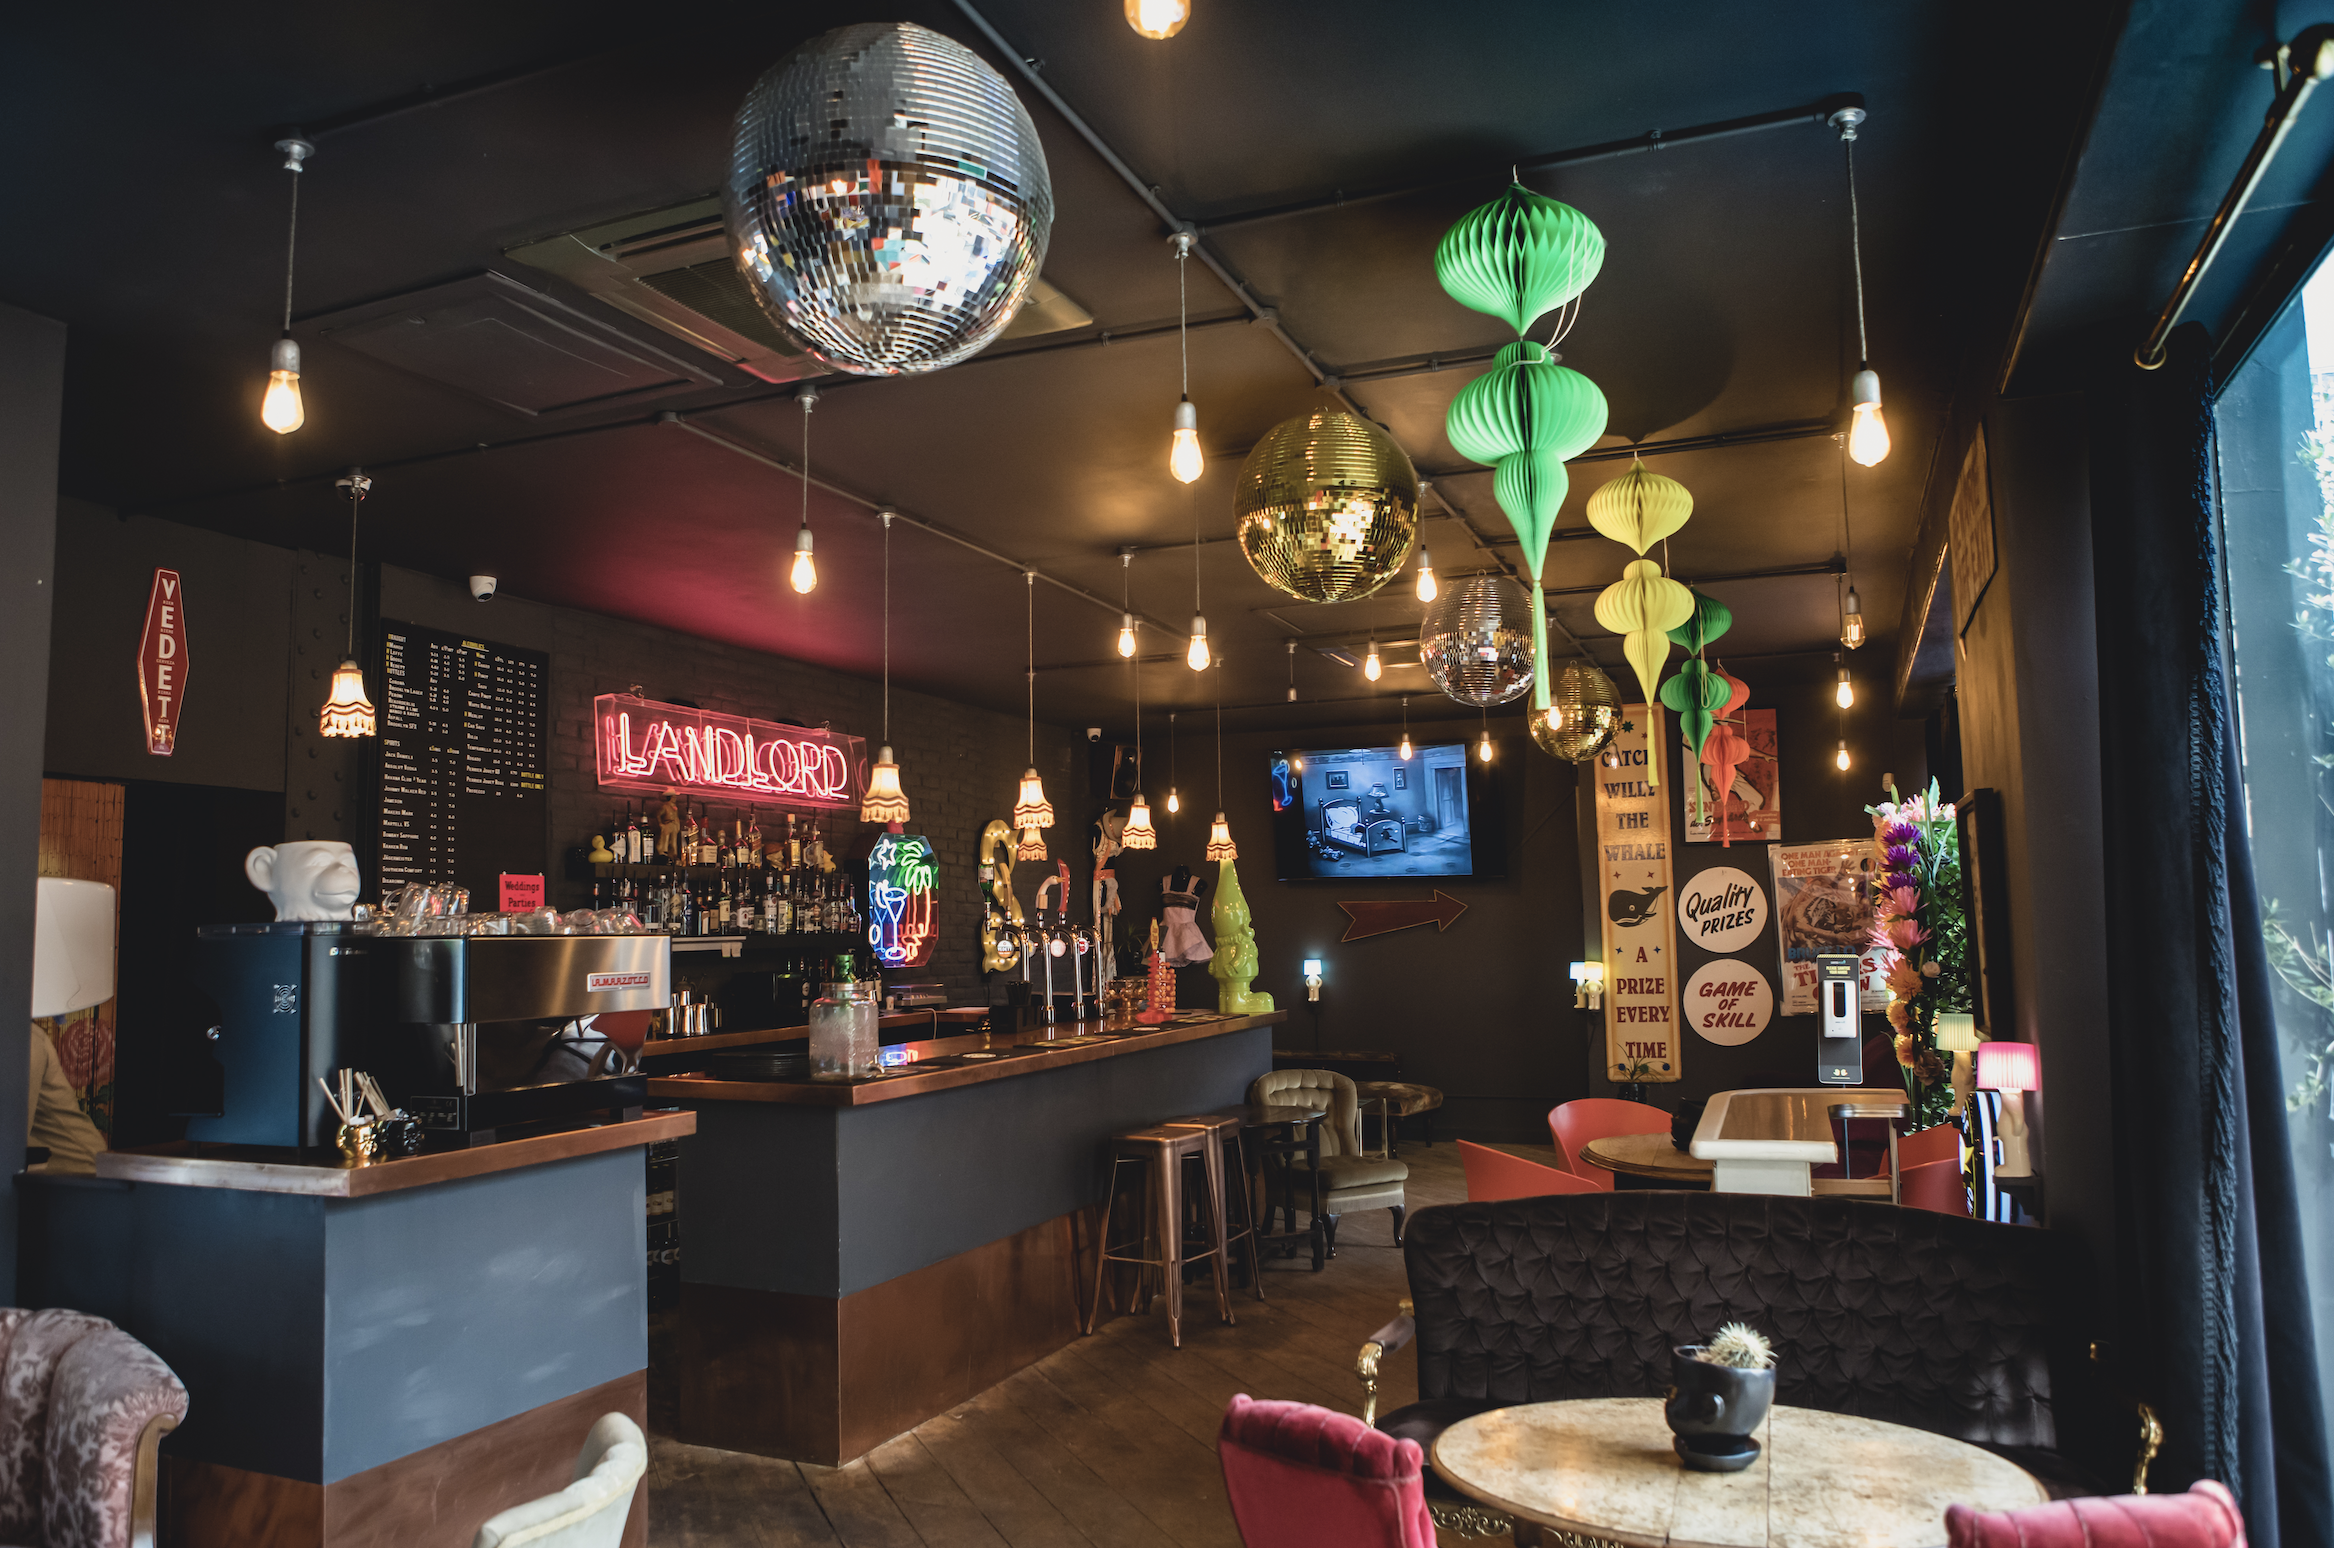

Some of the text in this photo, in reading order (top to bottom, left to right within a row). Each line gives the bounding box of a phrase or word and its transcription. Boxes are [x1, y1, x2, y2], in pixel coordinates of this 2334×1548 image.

[158, 578, 176, 744] VEDETT
[618, 712, 850, 799] LANDLORD
[1616, 812, 1649, 829] THE
[1604, 843, 1666, 861] WHALE
[1781, 852, 1799, 860] ONE
[1800, 850, 1821, 859] MAN
[1782, 866, 1836, 877] EATING TIGER
[1788, 860, 1806, 868] ONE
[505, 881, 540, 893] Weddings
[508, 897, 536, 907] Parties
[1686, 882, 1754, 923] Quality
[1701, 908, 1755, 936] PRIZES
[1636, 946, 1648, 963] A
[1616, 977, 1665, 995] PRIZE
[1699, 981, 1758, 997] GAME
[1718, 998, 1739, 1010] OF
[1616, 1006, 1670, 1023] EVERY
[1702, 1012, 1756, 1028] SKILL
[1625, 1042, 1667, 1058] TIME
